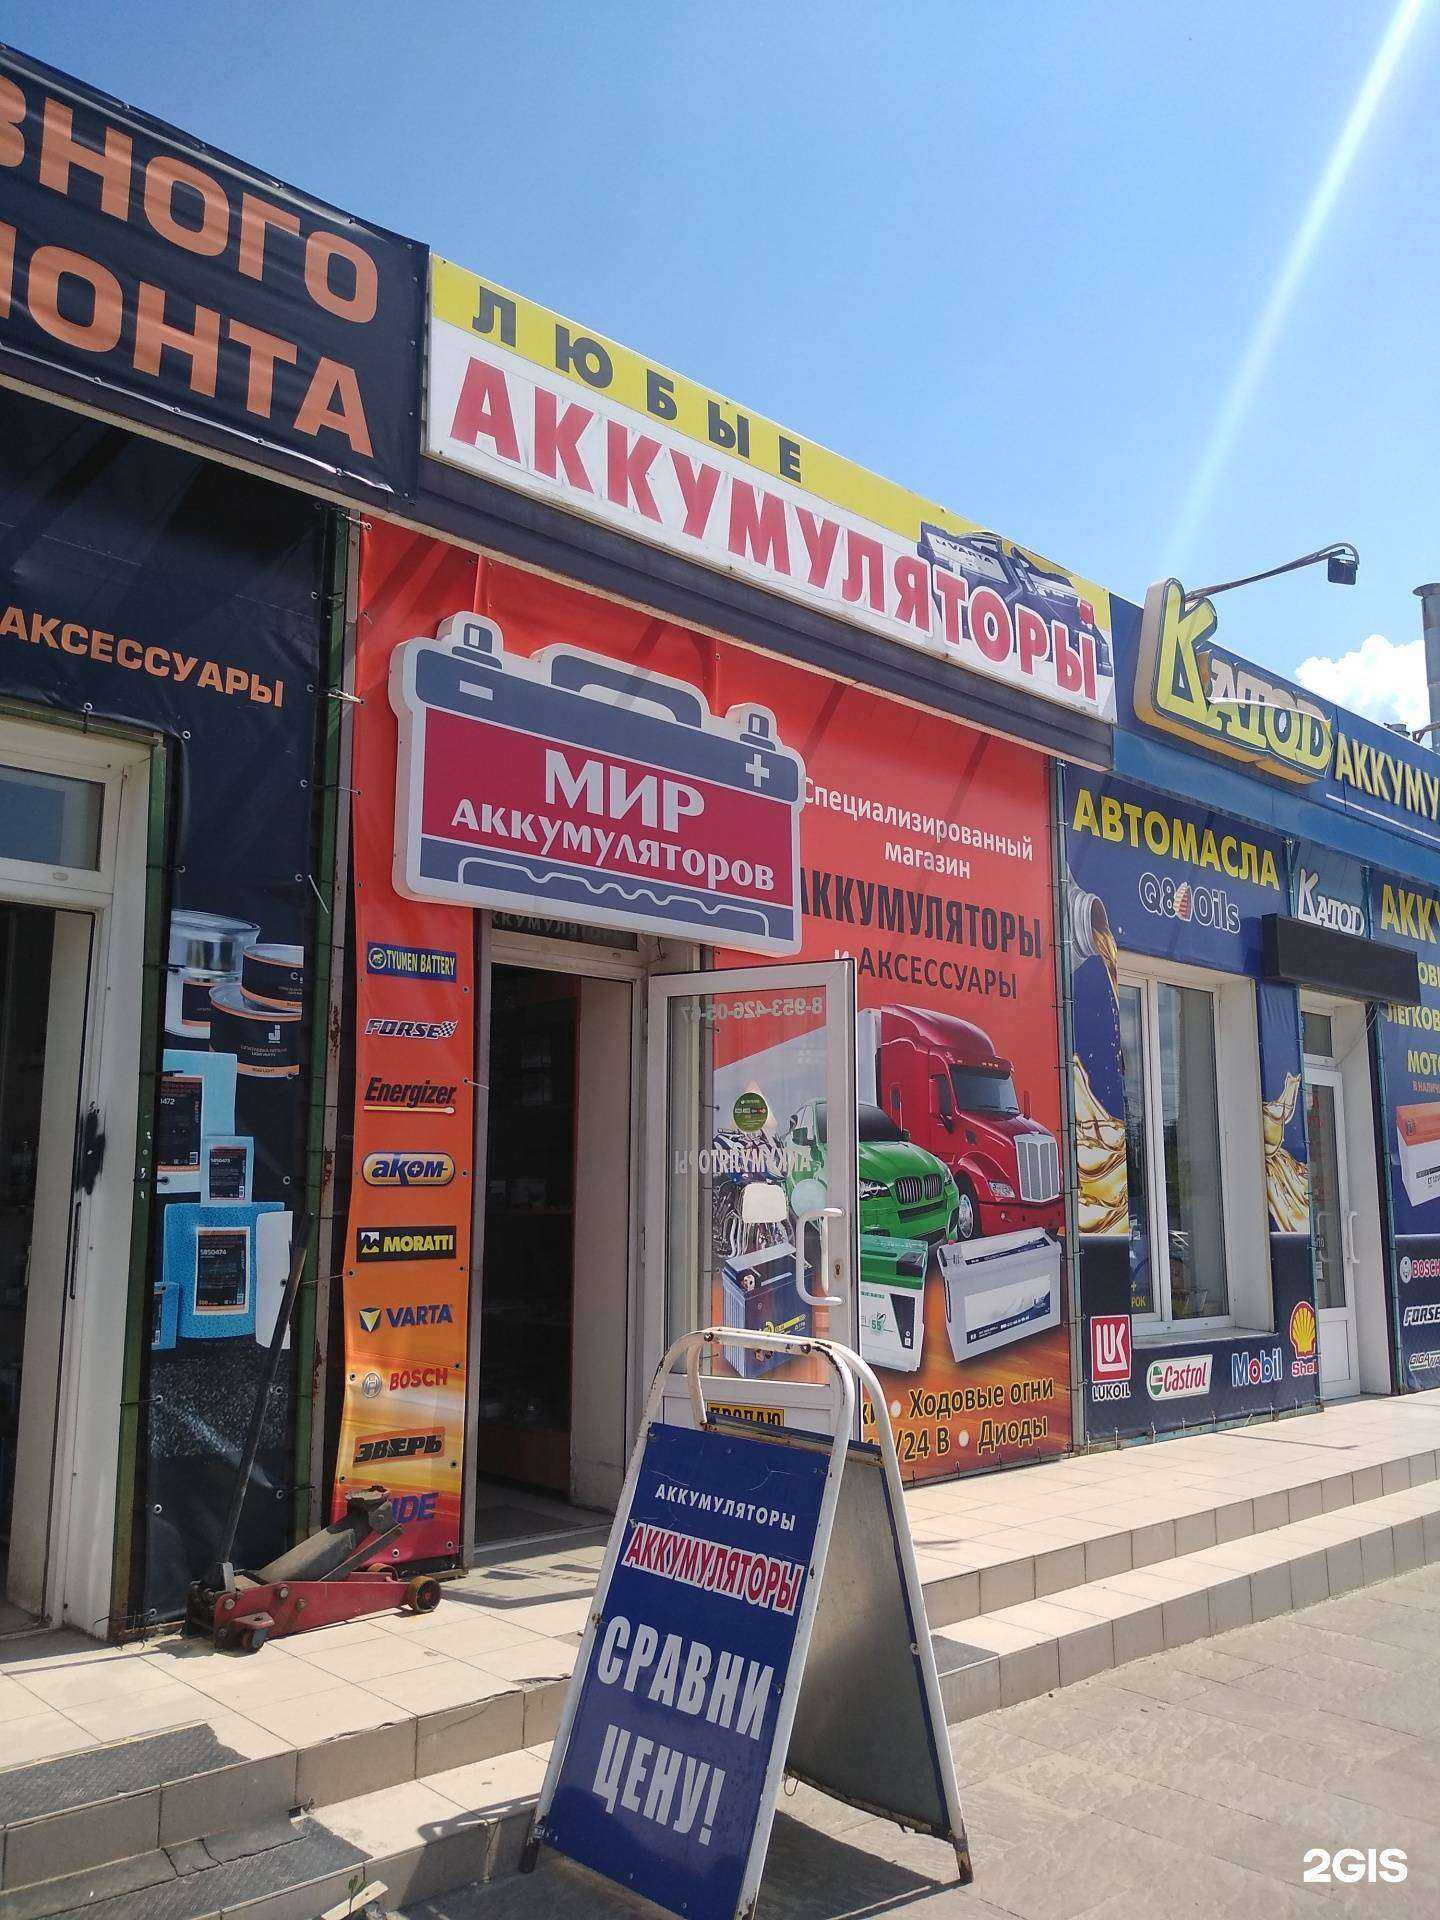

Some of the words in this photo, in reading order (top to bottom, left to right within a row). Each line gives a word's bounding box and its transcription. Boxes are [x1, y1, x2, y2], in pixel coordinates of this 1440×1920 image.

[0, 224, 374, 458] ОНТА
[472, 285, 801, 483] ЛЮБЫЕ
[449, 356, 1098, 702] АККУМУЛЯТОРЫ
[0, 606, 284, 708] АКСЕССУАРЫ
[545, 748, 705, 833] МИР
[1335, 732, 1440, 821] АККУМУ
[804, 777, 1033, 861] Специализированный
[1072, 788, 1281, 892] АВТОМАСЛА
[885, 842, 970, 879] магазин
[1191, 886, 1241, 934] Oils
[386, 949, 418, 972] TYUMEN
[420, 954, 456, 976] BATTERY
[858, 946, 1018, 1000] АКСЕССУАРЫ
[365, 1018, 443, 1040] FORSE
[1408, 1049, 1440, 1076] МОТ
[364, 1076, 457, 1108] Energizer
[384, 1234, 454, 1253] MORATTI
[386, 1304, 453, 1328] VARTA
[389, 1368, 448, 1391] BOSCH
[1163, 1362, 1208, 1393] Castrol
[1231, 1347, 1283, 1387] Mobil
[909, 1383, 1004, 1420] Ходовые
[1010, 1377, 1054, 1405] огни
[1092, 1383, 1131, 1401] LUKOIL
[355, 1434, 443, 1463] ЗВЕРЬ
[977, 1416, 1048, 1455] Диоды
[654, 1483, 797, 1532] АККУМУЛЯТОРЫ
[622, 1523, 805, 1616] АККУМУЛЯТОРЫ
[597, 1615, 775, 1741] СРАВНИ
[592, 1723, 727, 1847] ЦЕНУ!
